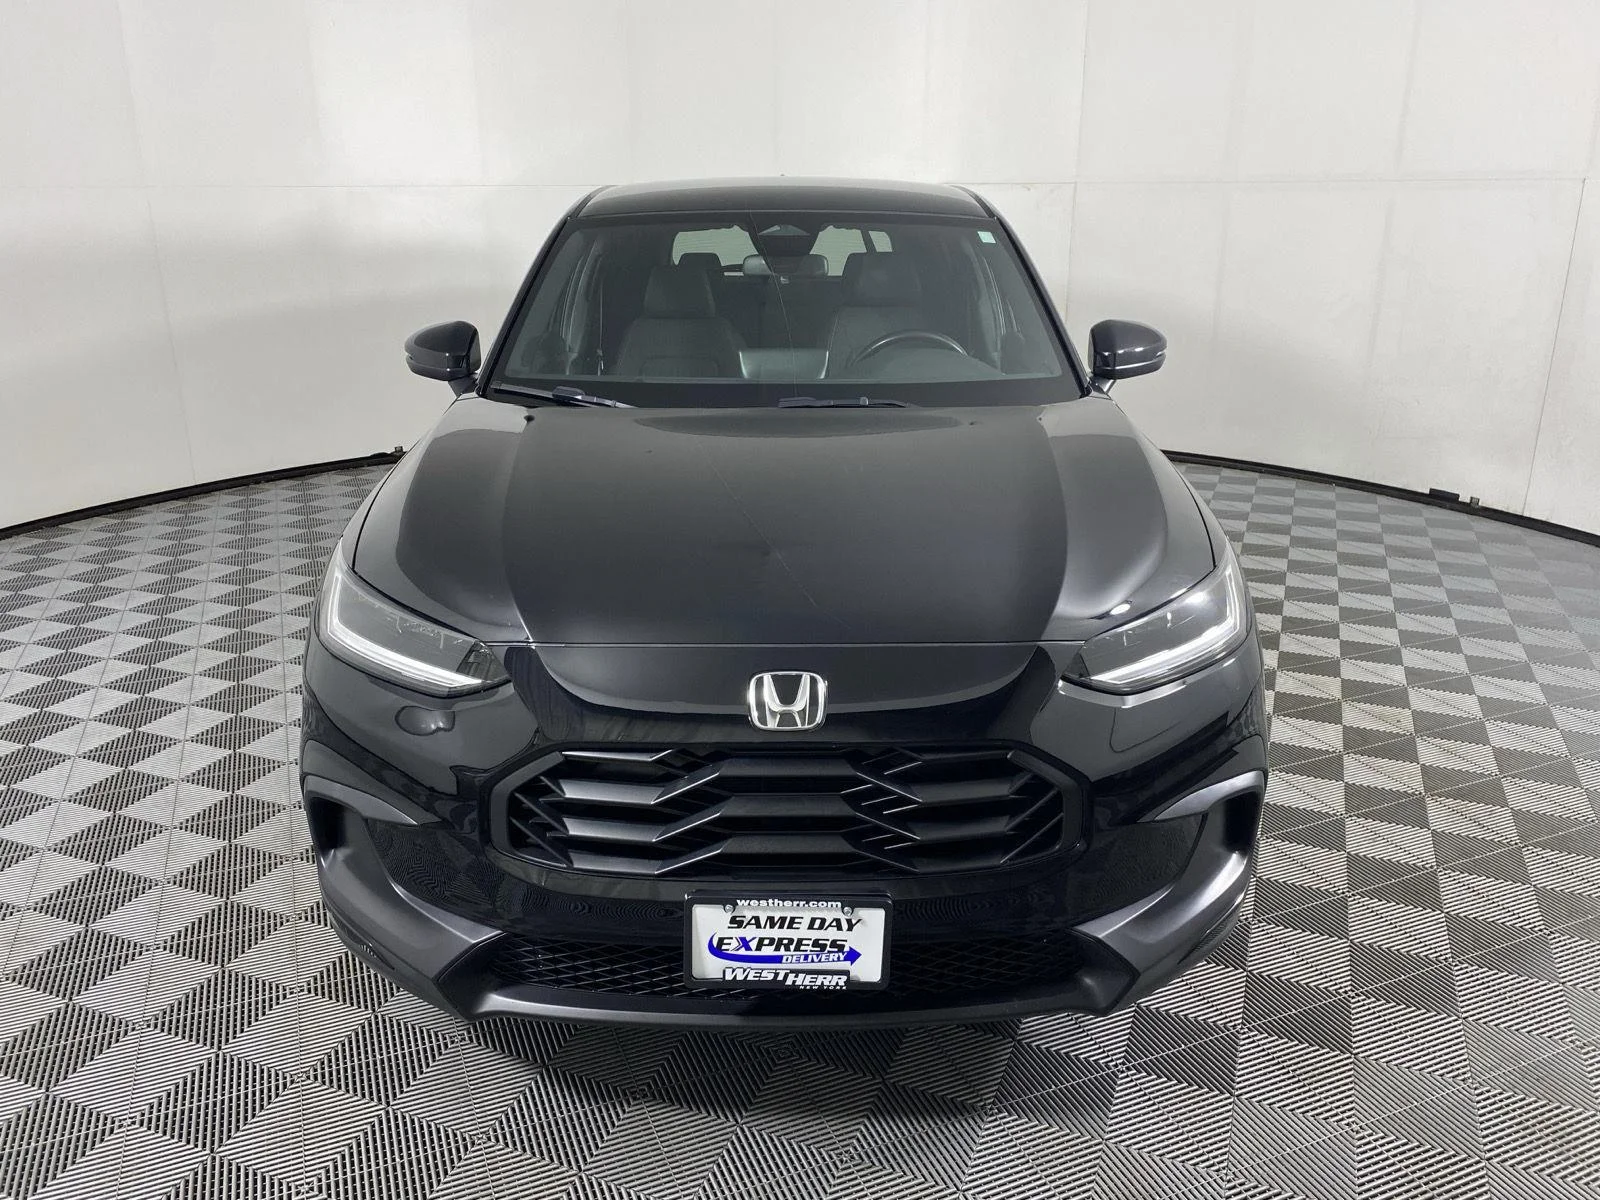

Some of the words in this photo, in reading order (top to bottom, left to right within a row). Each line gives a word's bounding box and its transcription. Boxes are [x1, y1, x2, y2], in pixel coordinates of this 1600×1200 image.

[736, 898, 842, 909] westherr.com
[727, 915, 804, 930] SAME
[807, 917, 863, 932] DAY
[716, 936, 848, 953] EXPRESS
[781, 952, 848, 965] DELIVERY
